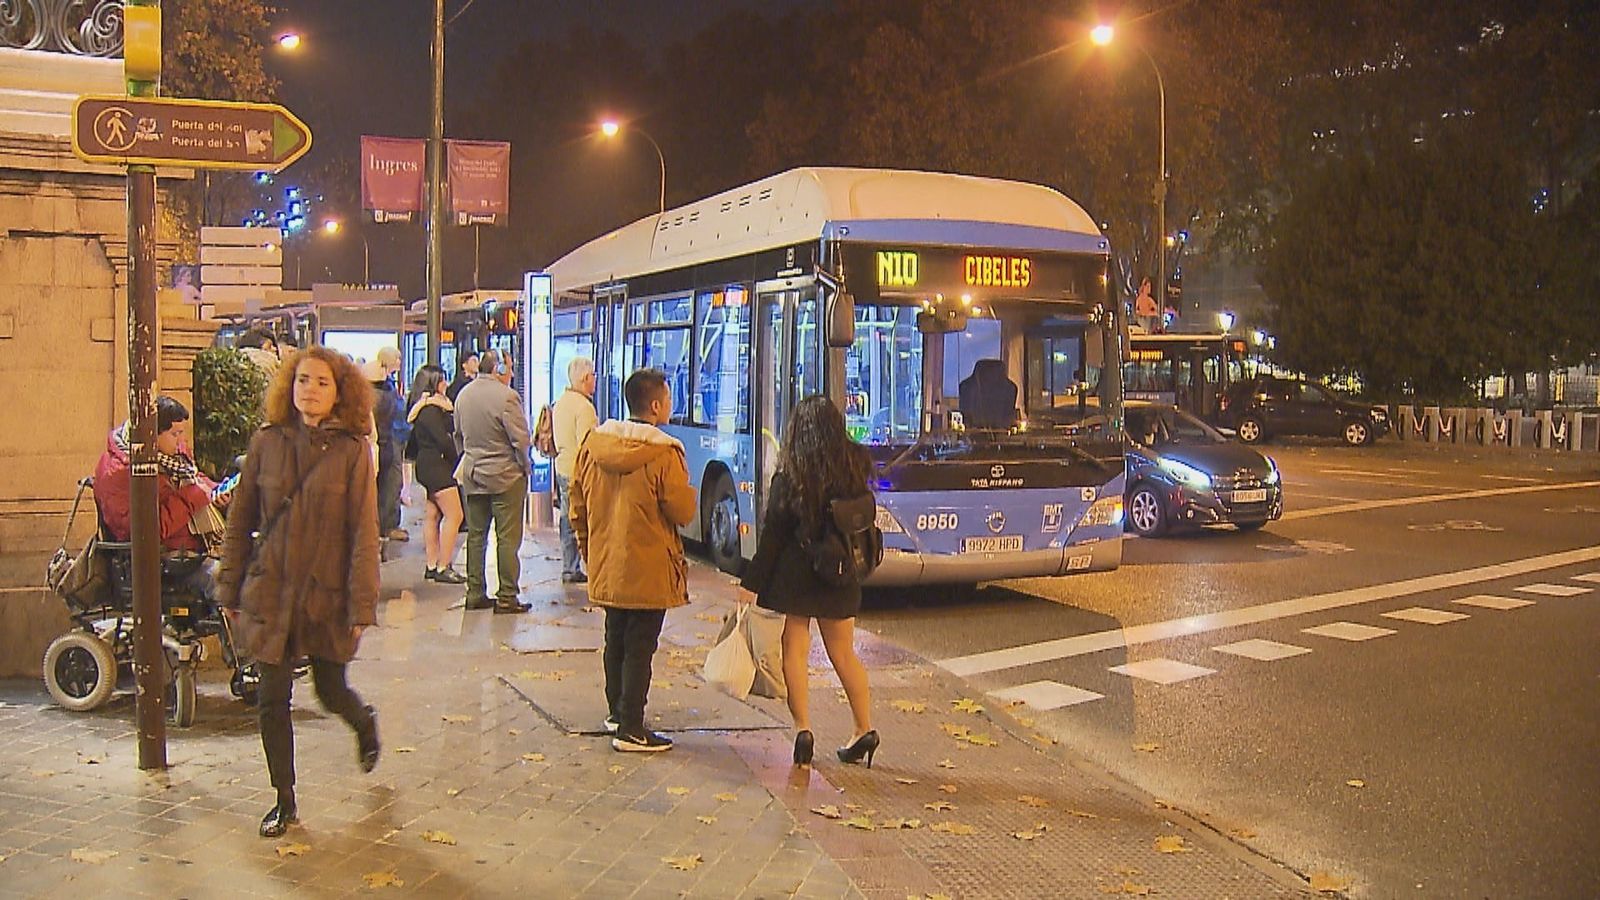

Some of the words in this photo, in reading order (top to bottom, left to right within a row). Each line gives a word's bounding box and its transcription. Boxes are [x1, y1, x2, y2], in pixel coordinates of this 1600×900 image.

[171, 119, 204, 131] Puerta
[171, 136, 204, 147] Puerta
[208, 138, 223, 149] del
[370, 153, 418, 176] Ingres
[877, 251, 917, 287] N10
[964, 255, 1032, 287] CIBELES
[916, 513, 959, 531] 8950
[968, 539, 996, 552] 9972
[998, 538, 1020, 551] HPD
